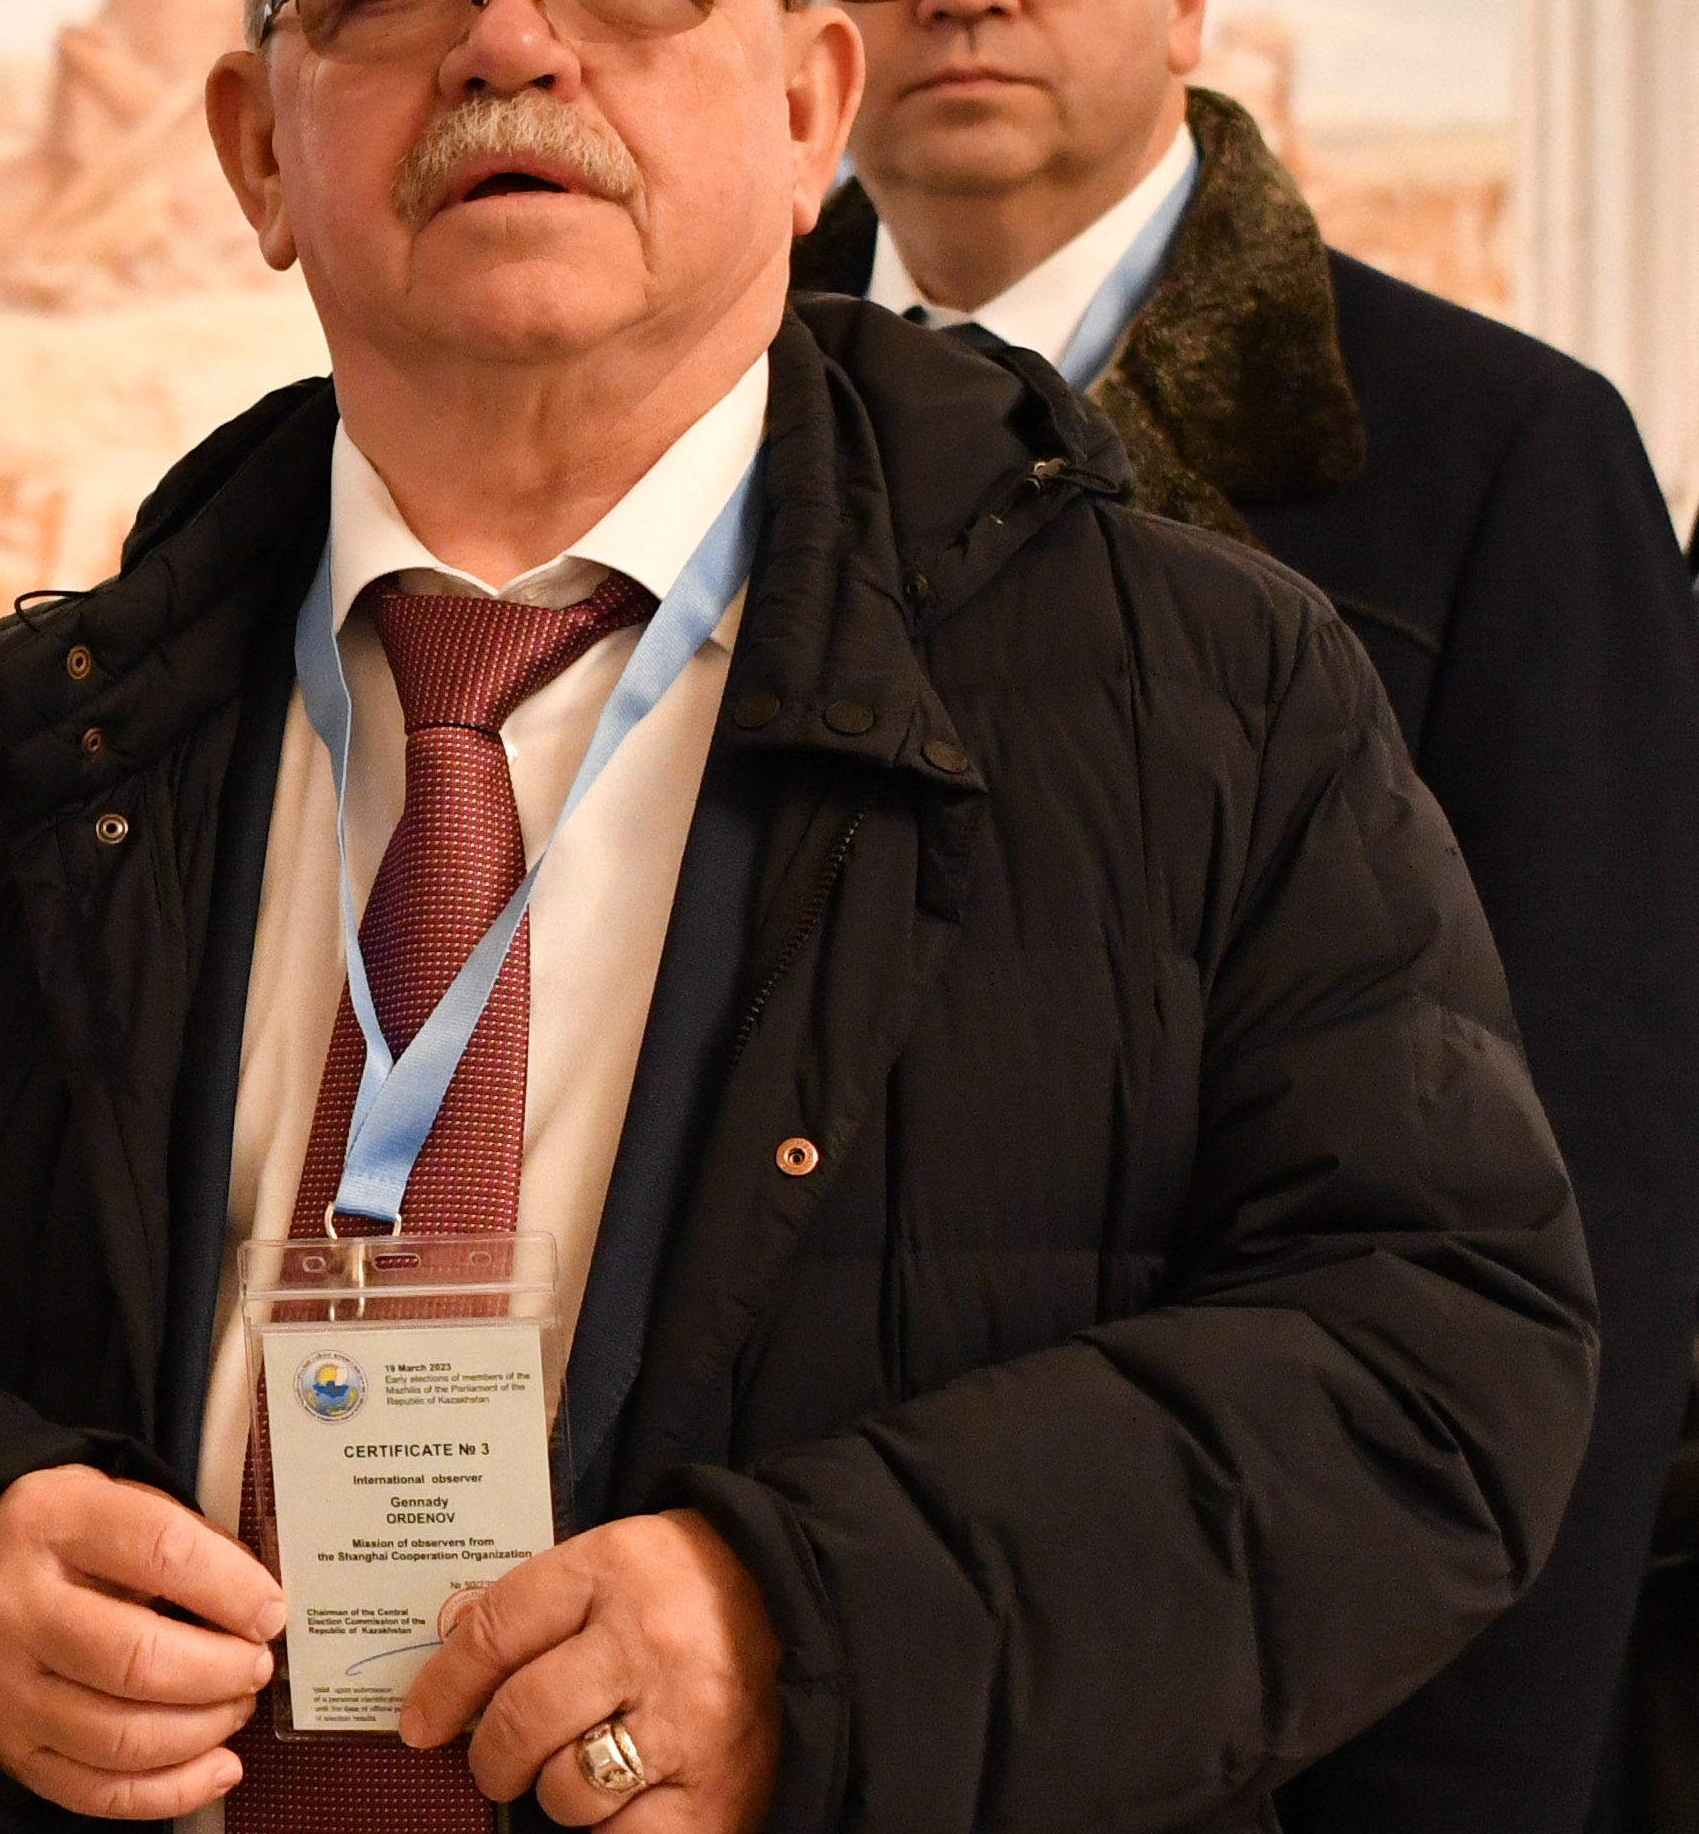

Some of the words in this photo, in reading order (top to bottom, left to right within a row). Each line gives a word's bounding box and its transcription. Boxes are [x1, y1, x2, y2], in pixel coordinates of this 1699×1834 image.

[398, 1364, 426, 1372] March
[430, 1363, 451, 1371] 2023
[411, 1374, 448, 1382] elections
[462, 1373, 502, 1381] members
[517, 1372, 530, 1380] the
[424, 1386, 432, 1394] of
[438, 1395, 489, 1404] Kazakhstan
[344, 1444, 452, 1458] CERTIFICATE
[459, 1443, 476, 1455] №
[481, 1443, 490, 1455] 3
[354, 1475, 425, 1485] International
[432, 1474, 483, 1484] observer
[391, 1497, 448, 1508] Gennady
[387, 1513, 455, 1524] ORDENOV
[352, 1539, 394, 1548] Mission
[397, 1538, 407, 1547] of
[412, 1538, 465, 1547] observers
[469, 1538, 494, 1546] from
[318, 1553, 334, 1561] the
[338, 1552, 388, 1563] Shanghai
[392, 1551, 458, 1562] Cooperation
[462, 1550, 532, 1561] Organization
[309, 1627, 345, 1635] Republic
